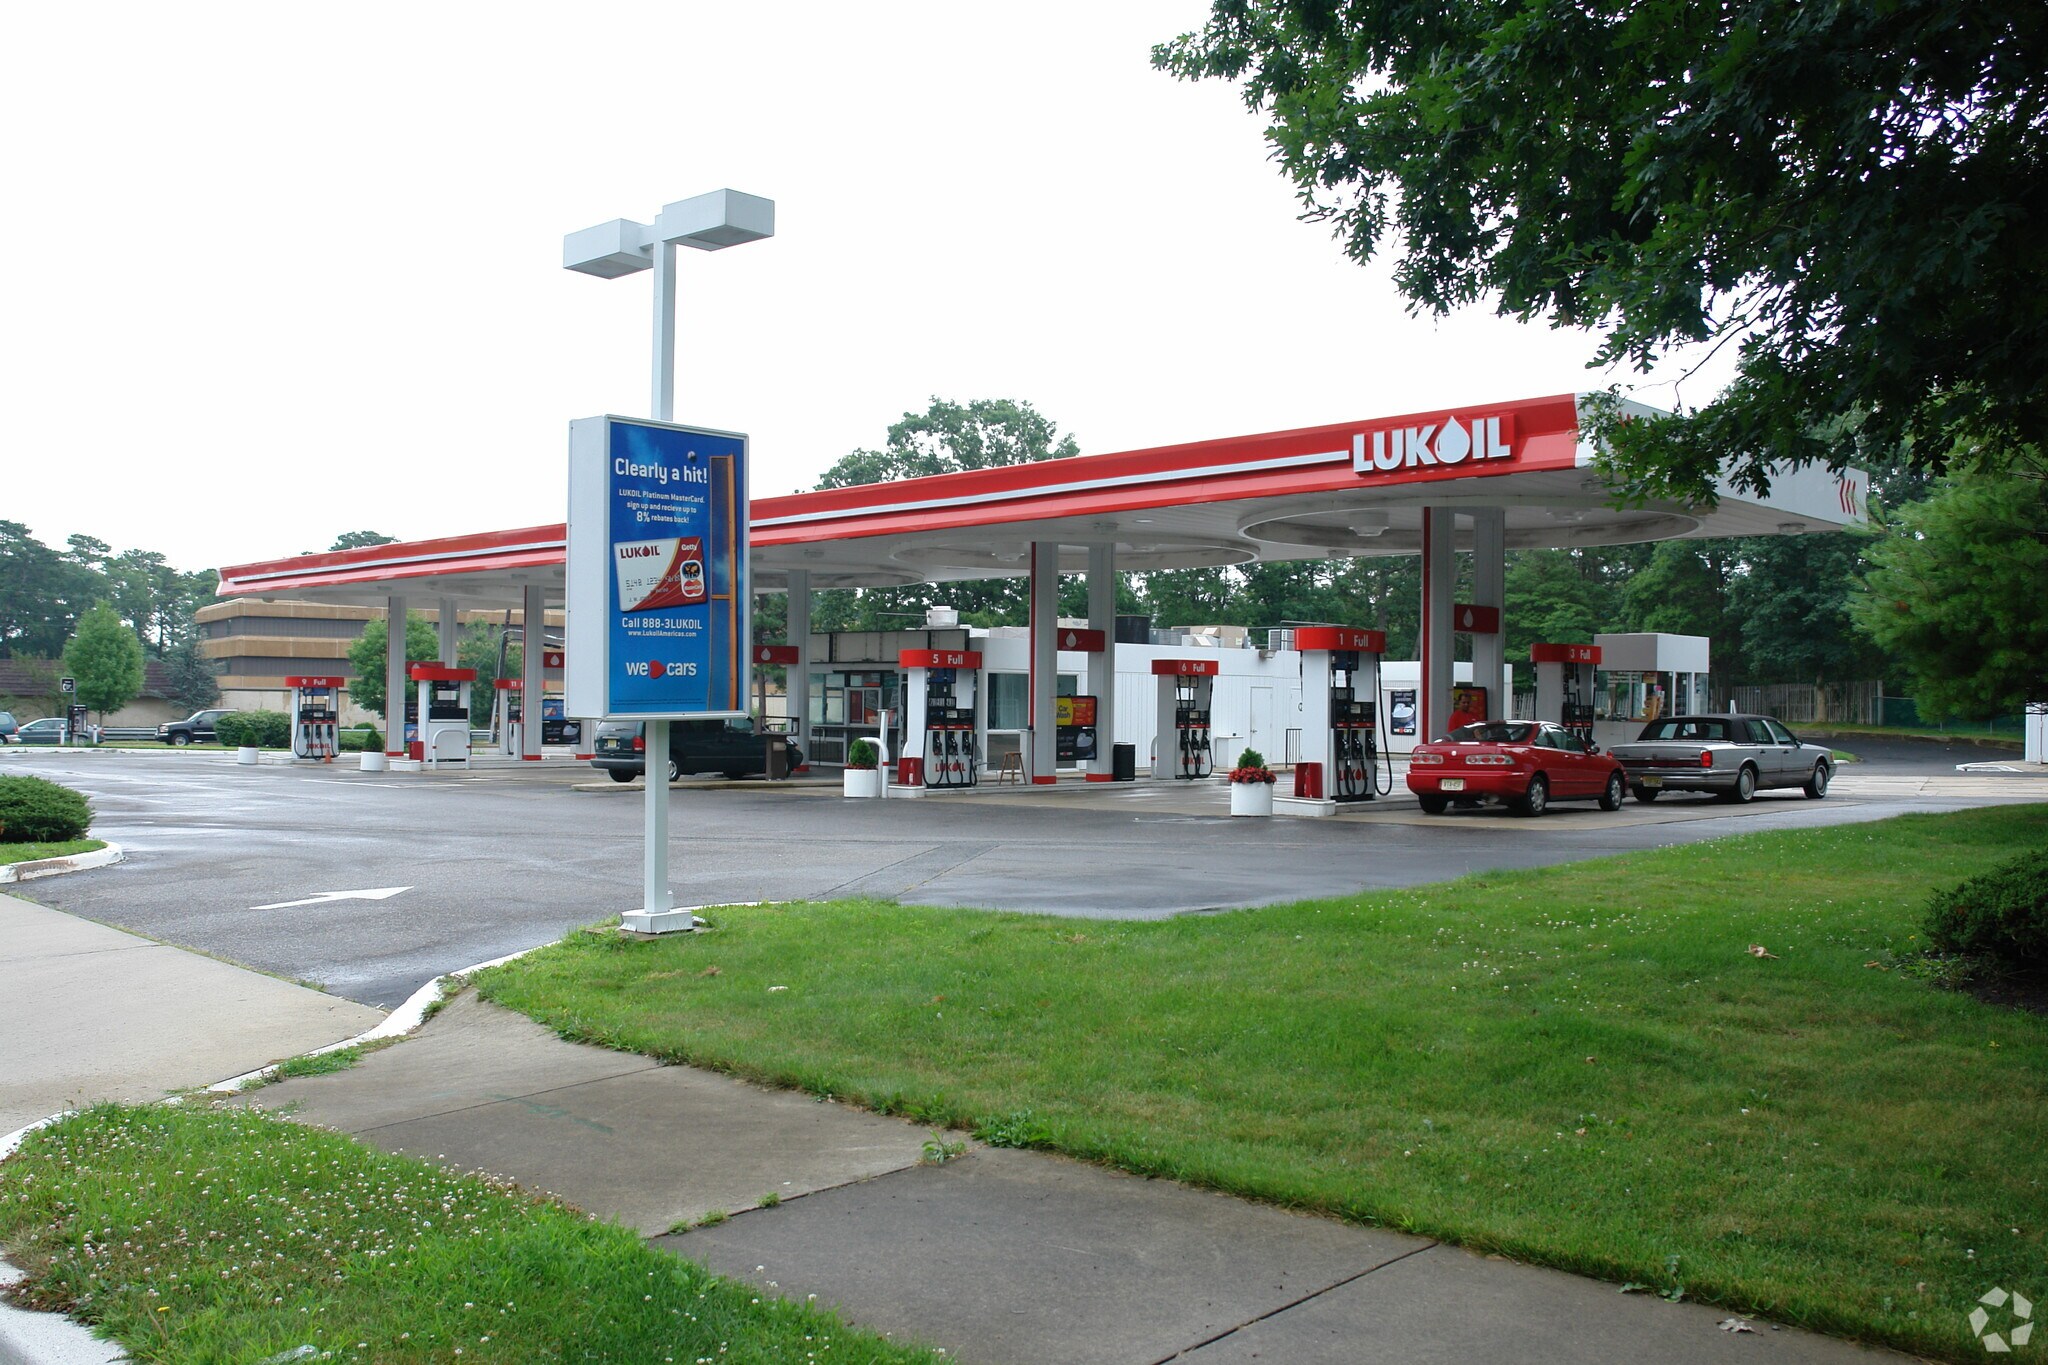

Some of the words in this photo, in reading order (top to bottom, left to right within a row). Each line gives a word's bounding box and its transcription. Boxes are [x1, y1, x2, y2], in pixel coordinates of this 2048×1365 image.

[1353, 416, 1512, 473] LUKOIL
[615, 457, 668, 485] Clearly
[671, 468, 680, 481] a
[683, 465, 708, 484] hit!
[618, 488, 642, 498] LUKOIL
[642, 490, 670, 501] Platinum
[626, 500, 640, 511] sign
[640, 502, 649, 511] up
[649, 502, 661, 511] and
[682, 505, 690, 514] up
[690, 505, 697, 514] to
[636, 511, 651, 523] 8%
[651, 514, 673, 523] rebates
[673, 515, 690, 524] back!
[620, 545, 660, 559] LUKOIL
[622, 617, 640, 628] Call
[642, 618, 703, 629] 888-3LUKOIL
[1339, 633, 1344, 646] 1
[1353, 634, 1369, 647] Full
[932, 654, 939, 664] 5
[947, 654, 964, 665] Full
[1570, 648, 1576, 659] 3
[1580, 649, 1591, 660] Full
[626, 661, 649, 676] we
[666, 660, 697, 677] cars
[1181, 662, 1187, 672] 6
[1192, 663, 1206, 673] Full
[313, 678, 327, 686] Full
[1058, 704, 1068, 712] Car
[1181, 756, 1206, 766] LUKIL
